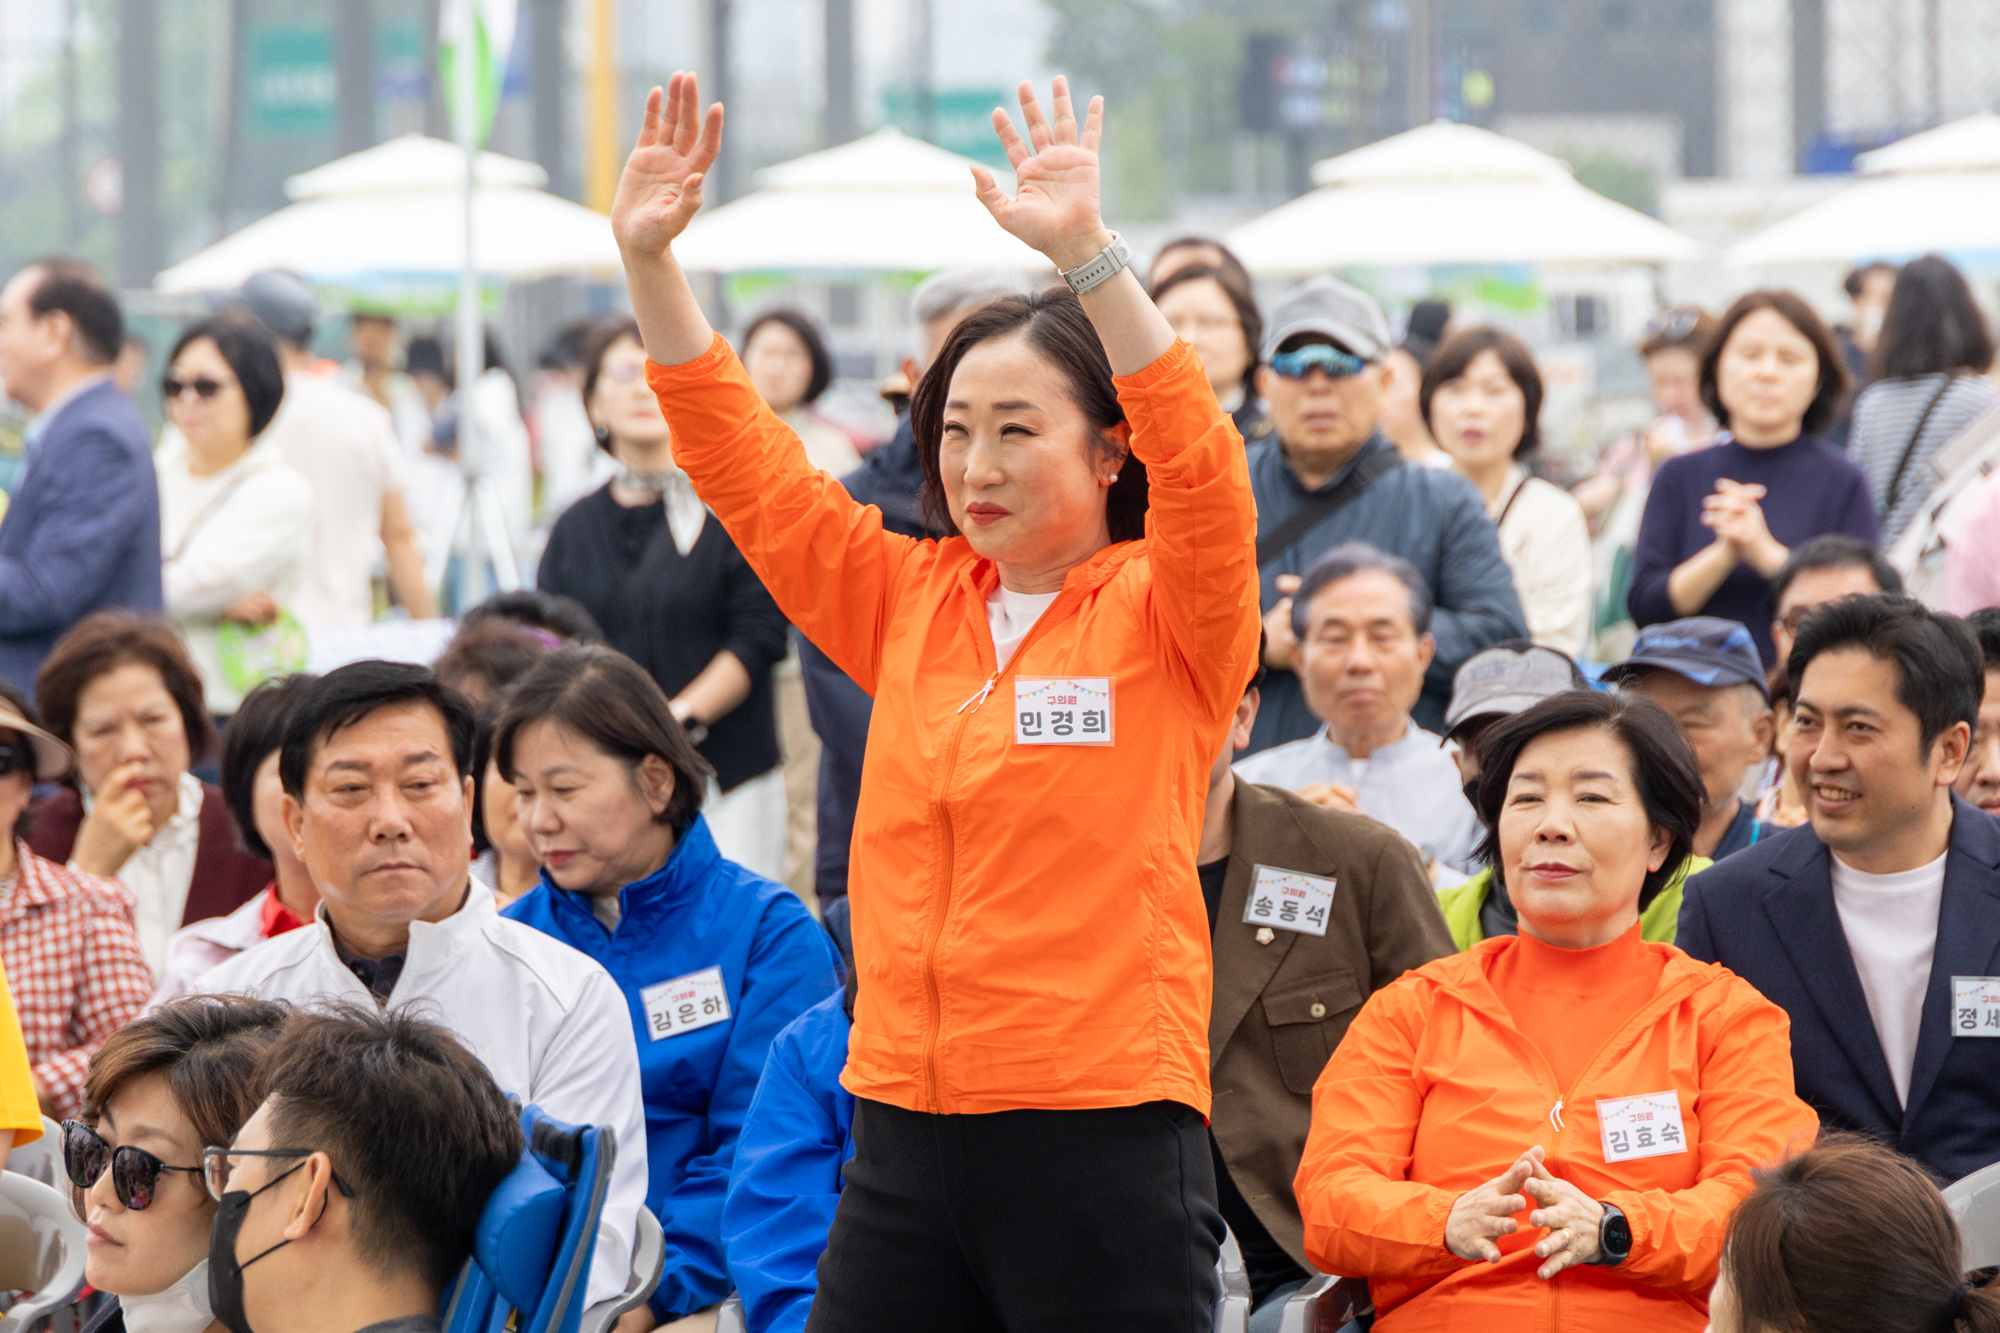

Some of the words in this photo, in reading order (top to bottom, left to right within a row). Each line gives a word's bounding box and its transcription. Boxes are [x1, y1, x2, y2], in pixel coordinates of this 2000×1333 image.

[1047, 695, 1077, 706] 구의원
[1020, 709, 1106, 736] 민경희
[1281, 886, 1307, 899] 구의원
[1254, 896, 1325, 928] 송동석
[1981, 995, 2000, 1004] 구의
[652, 995, 722, 1032] 김은하
[1628, 1112, 1654, 1123] 구의원
[1609, 1122, 1680, 1153] 김효숙
